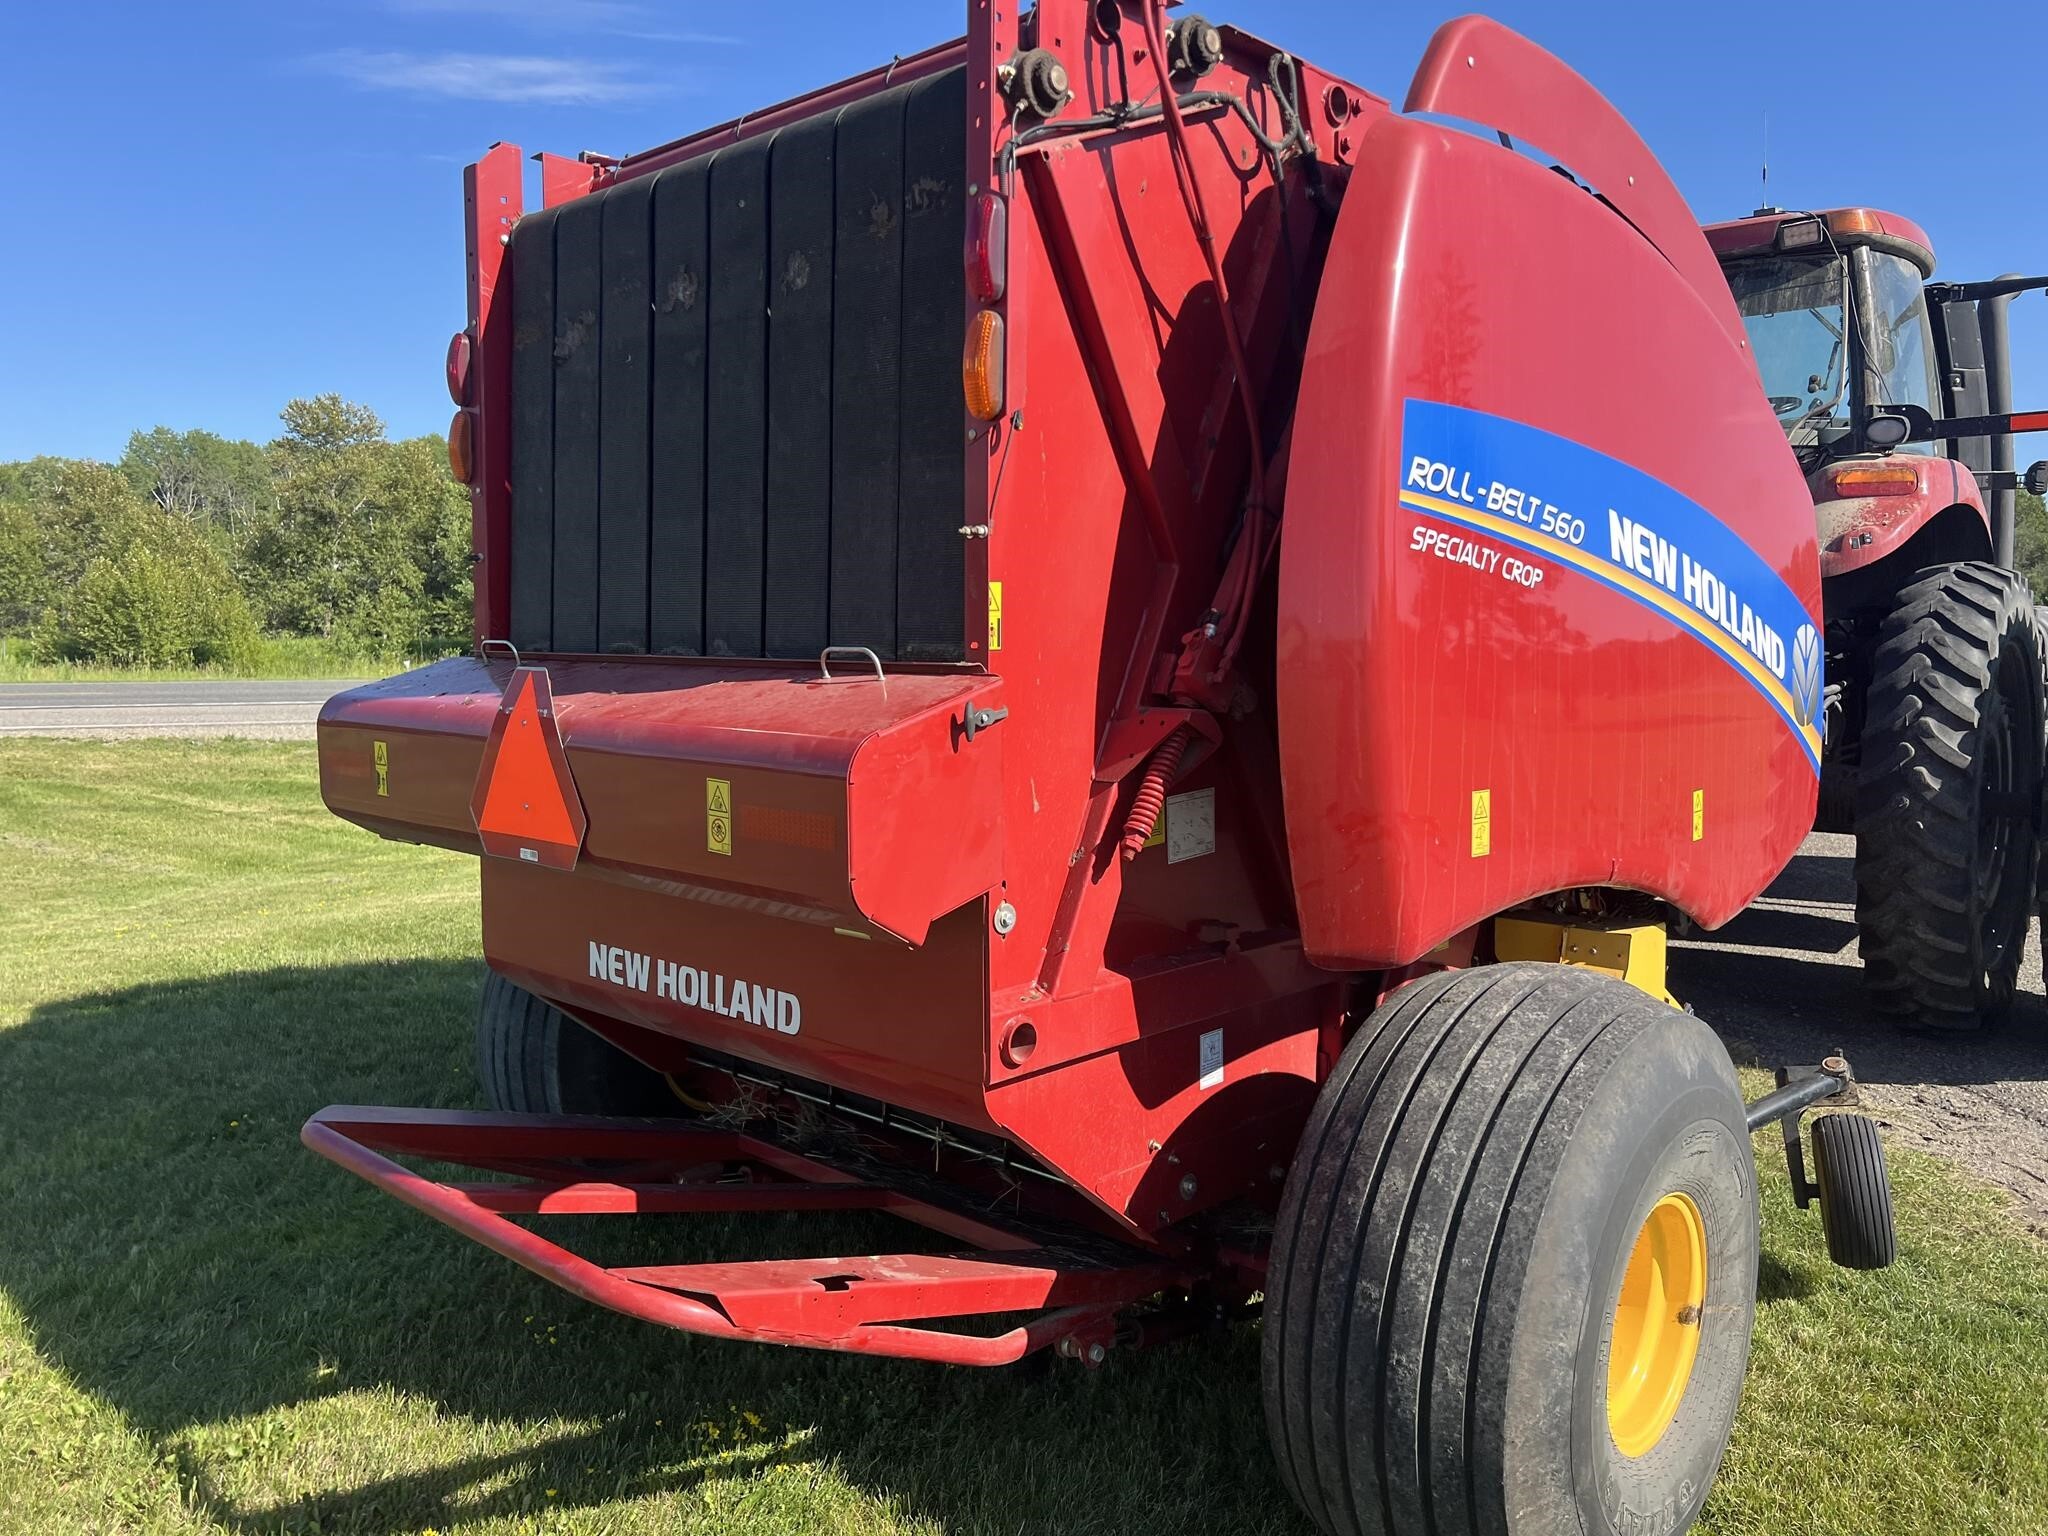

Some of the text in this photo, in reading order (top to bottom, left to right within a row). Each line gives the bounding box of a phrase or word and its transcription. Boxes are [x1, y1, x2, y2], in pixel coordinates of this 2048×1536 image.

[1407, 456, 1586, 545] ROLL-BELT 560
[1410, 526, 1544, 589] SPECIALTY CROP
[1609, 509, 1786, 680] NEW HOLLAND
[589, 941, 801, 1036] NEW HOLLAND
